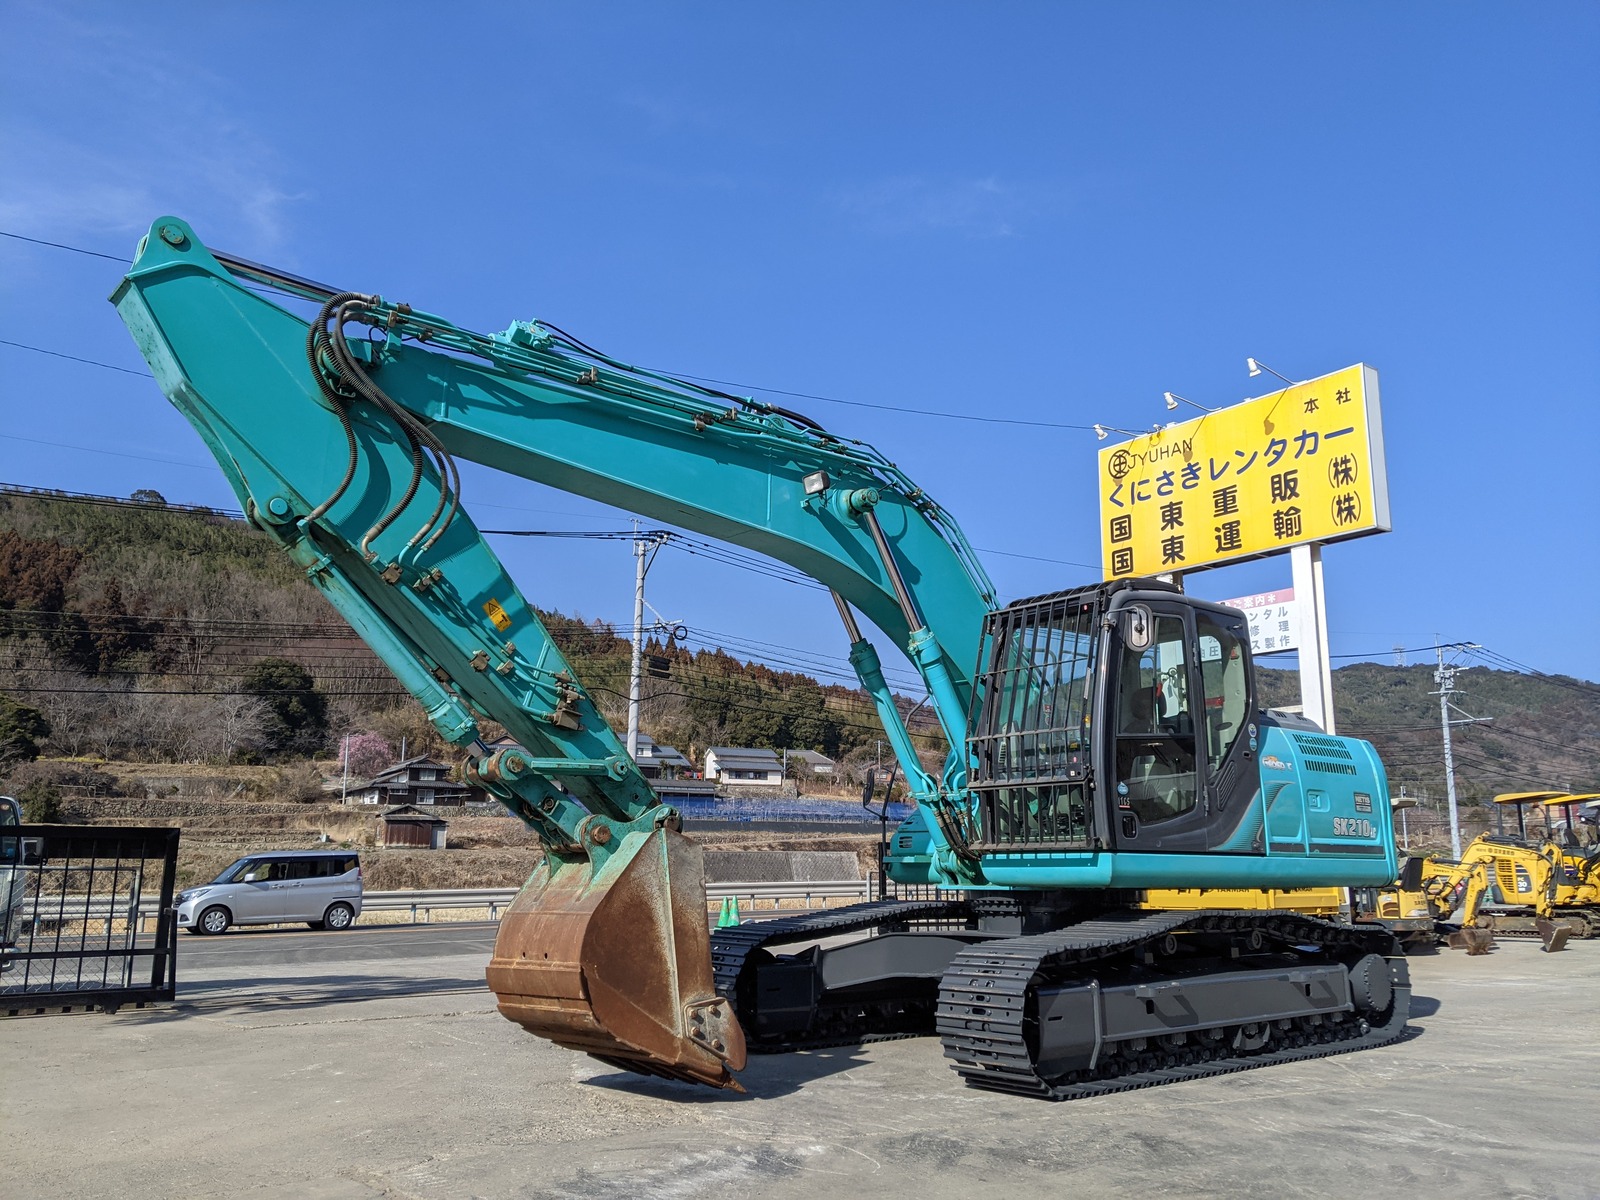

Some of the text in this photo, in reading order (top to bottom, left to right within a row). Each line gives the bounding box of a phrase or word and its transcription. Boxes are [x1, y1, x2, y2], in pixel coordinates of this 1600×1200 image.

[1304, 387, 1352, 414] 本社
[1109, 427, 1355, 508] くにさきレンタカー
[1127, 438, 1192, 469] JYUHAN
